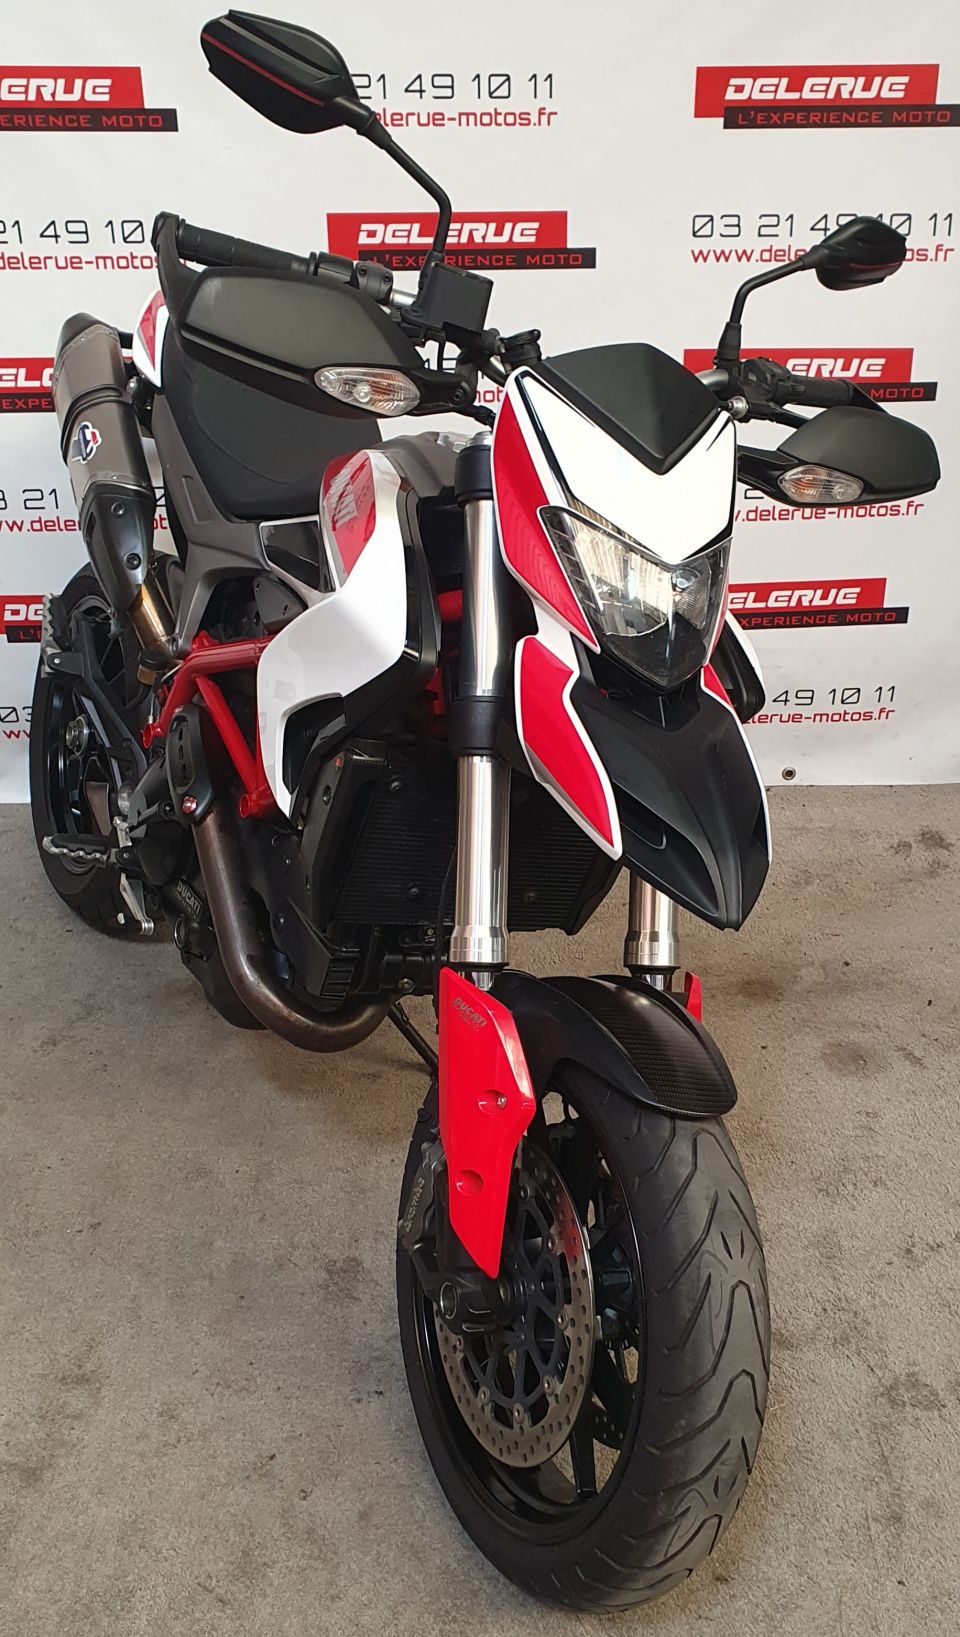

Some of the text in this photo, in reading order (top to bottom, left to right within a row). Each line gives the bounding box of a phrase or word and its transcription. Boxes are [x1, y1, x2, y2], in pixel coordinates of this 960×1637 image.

[404, 73, 454, 99] 49
[472, 73, 511, 99] 10
[528, 73, 553, 99] 11
[724, 76, 909, 100] DELERUE
[102, 115, 163, 128] MOTO
[738, 110, 951, 125] L'EXPERIENCE MOTO
[39, 219, 90, 244] 49
[104, 219, 145, 244] 10
[692, 214, 741, 238] 03
[758, 214, 794, 237] 21
[928, 213, 953, 236] 11
[526, 254, 582, 265] MOTO
[870, 388, 924, 399] MOTO
[22, 488, 59, 510] 21
[846, 611, 896, 622] MOTO
[772, 686, 896, 706] 49 10 11
[176, 880, 200, 915] DUCATI
[453, 997, 487, 1027] DUCATI
